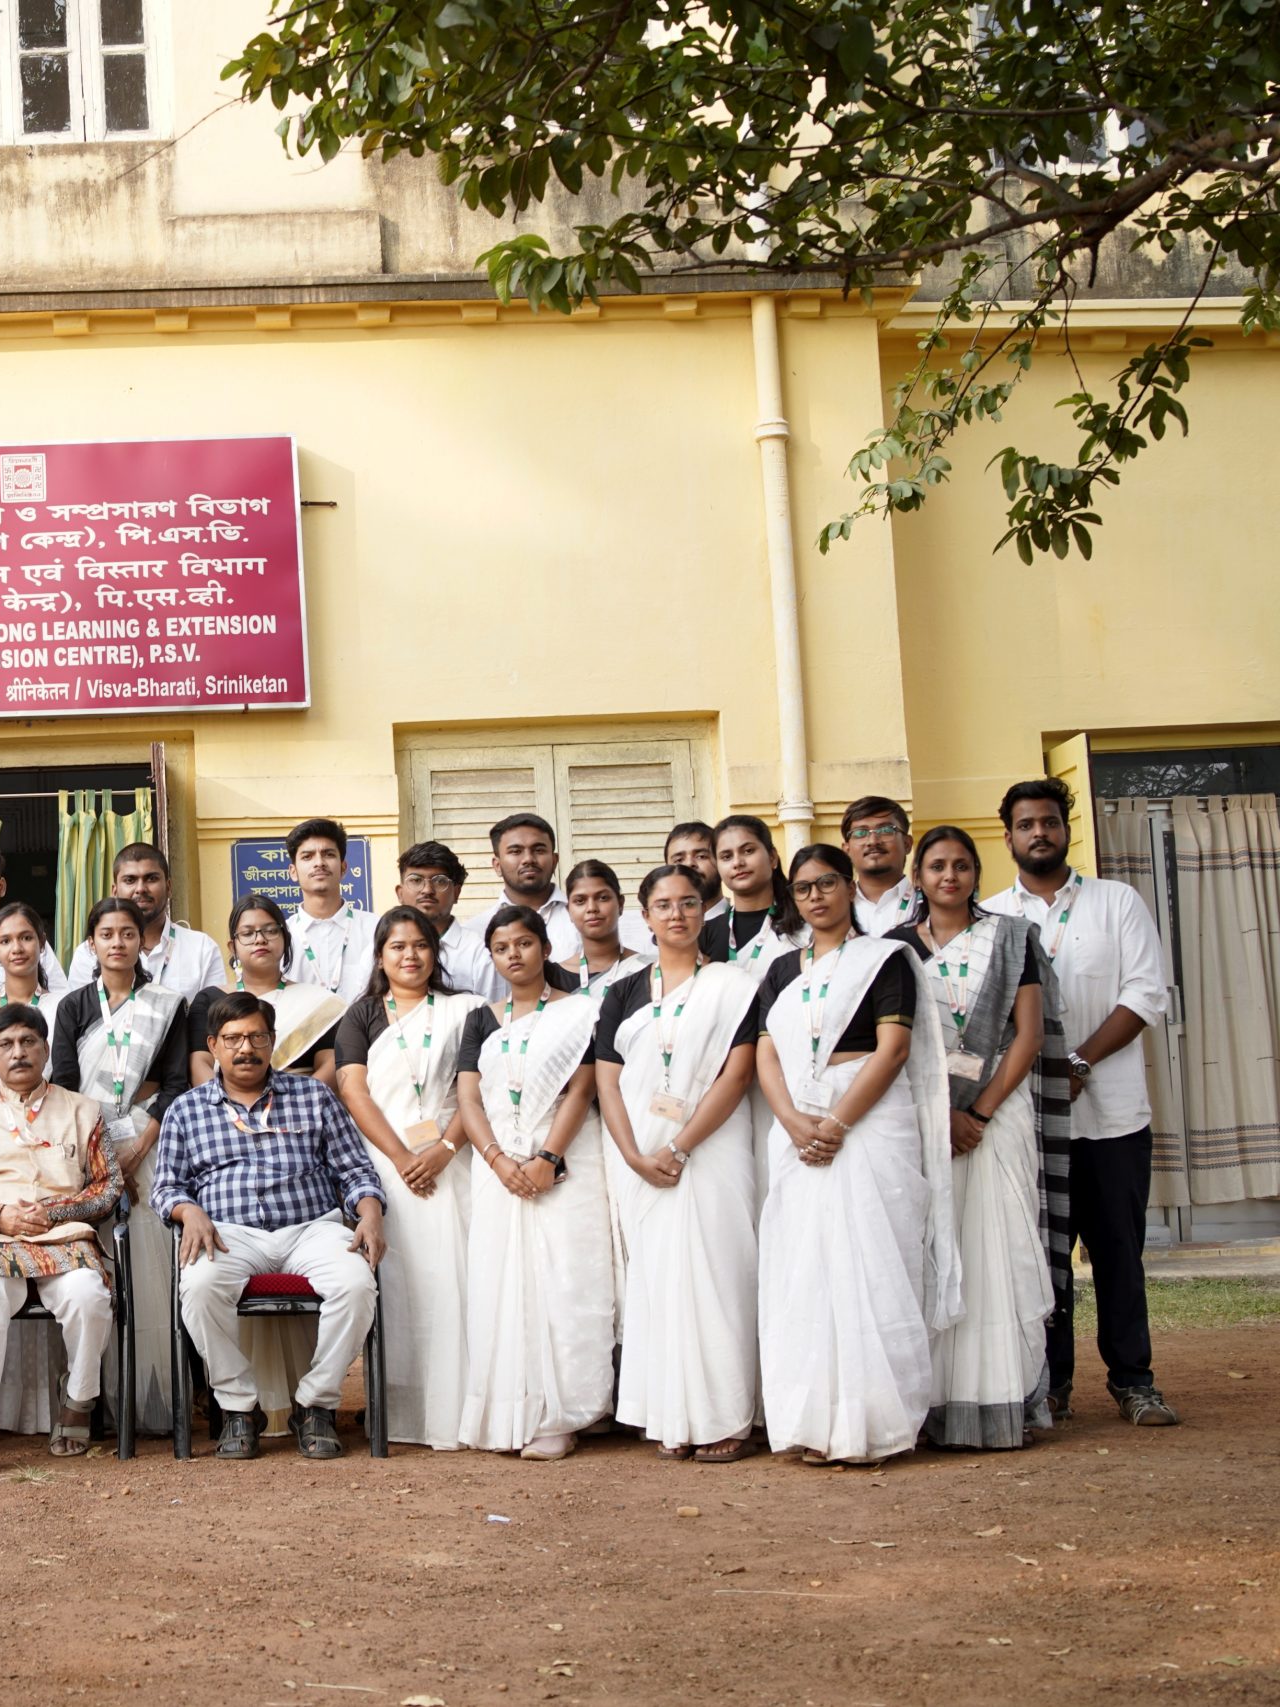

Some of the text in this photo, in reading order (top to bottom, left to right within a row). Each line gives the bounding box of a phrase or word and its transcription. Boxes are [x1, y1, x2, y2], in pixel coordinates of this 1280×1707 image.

[15, 506, 37, 522] ও
[45, 499, 178, 522] সম্প্রসারণ
[185, 494, 271, 517] বিভাগ
[20, 525, 106, 550] কেন্দ্র),
[20, 558, 65, 587] एवं
[74, 555, 169, 581] विस्तार
[177, 552, 268, 577] विभाग
[0, 587, 82, 614] केन्द्र),
[41, 618, 140, 641] LEARNING
[146, 618, 161, 638] &
[166, 615, 276, 637] EXTENSION
[53, 644, 144, 669] CENTRE),
[149, 643, 201, 663] P.S.V.
[5, 677, 70, 702] श्रीनिकेतन
[74, 676, 81, 701] /
[86, 676, 200, 698] Visva-Bharati,
[205, 674, 288, 695] Sriniketan
[350, 866, 362, 878] ও
[250, 885, 301, 899] সম্প্রসার
